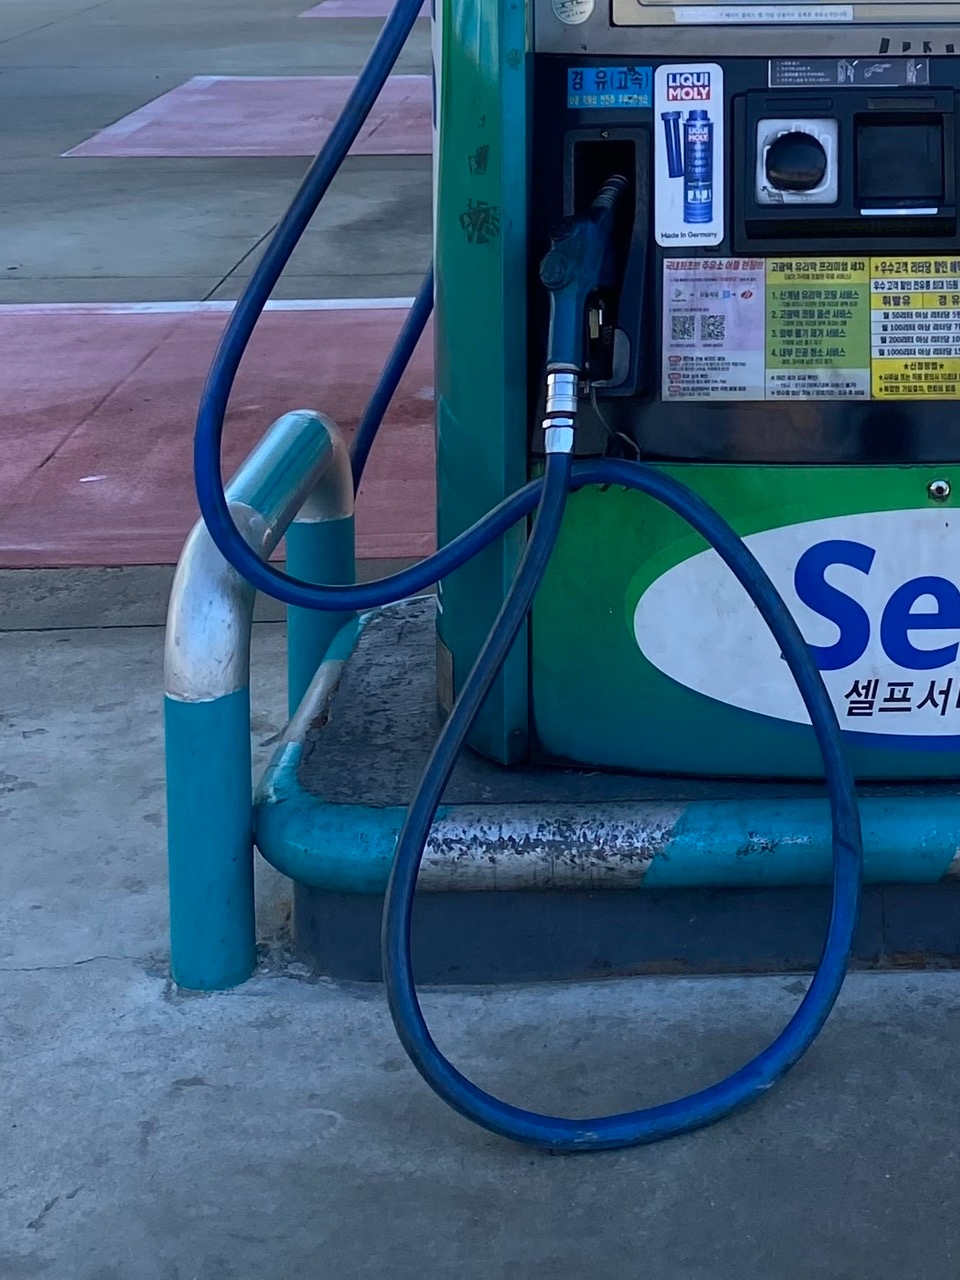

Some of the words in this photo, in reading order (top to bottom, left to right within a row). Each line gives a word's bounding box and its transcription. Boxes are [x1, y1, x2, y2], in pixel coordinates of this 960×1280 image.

[668, 73, 709, 86] LIQUI
[668, 87, 711, 100] MOLY
[688, 126, 709, 134] LIQUI
[688, 134, 708, 142] MOLY
[688, 231, 717, 240] Germany
